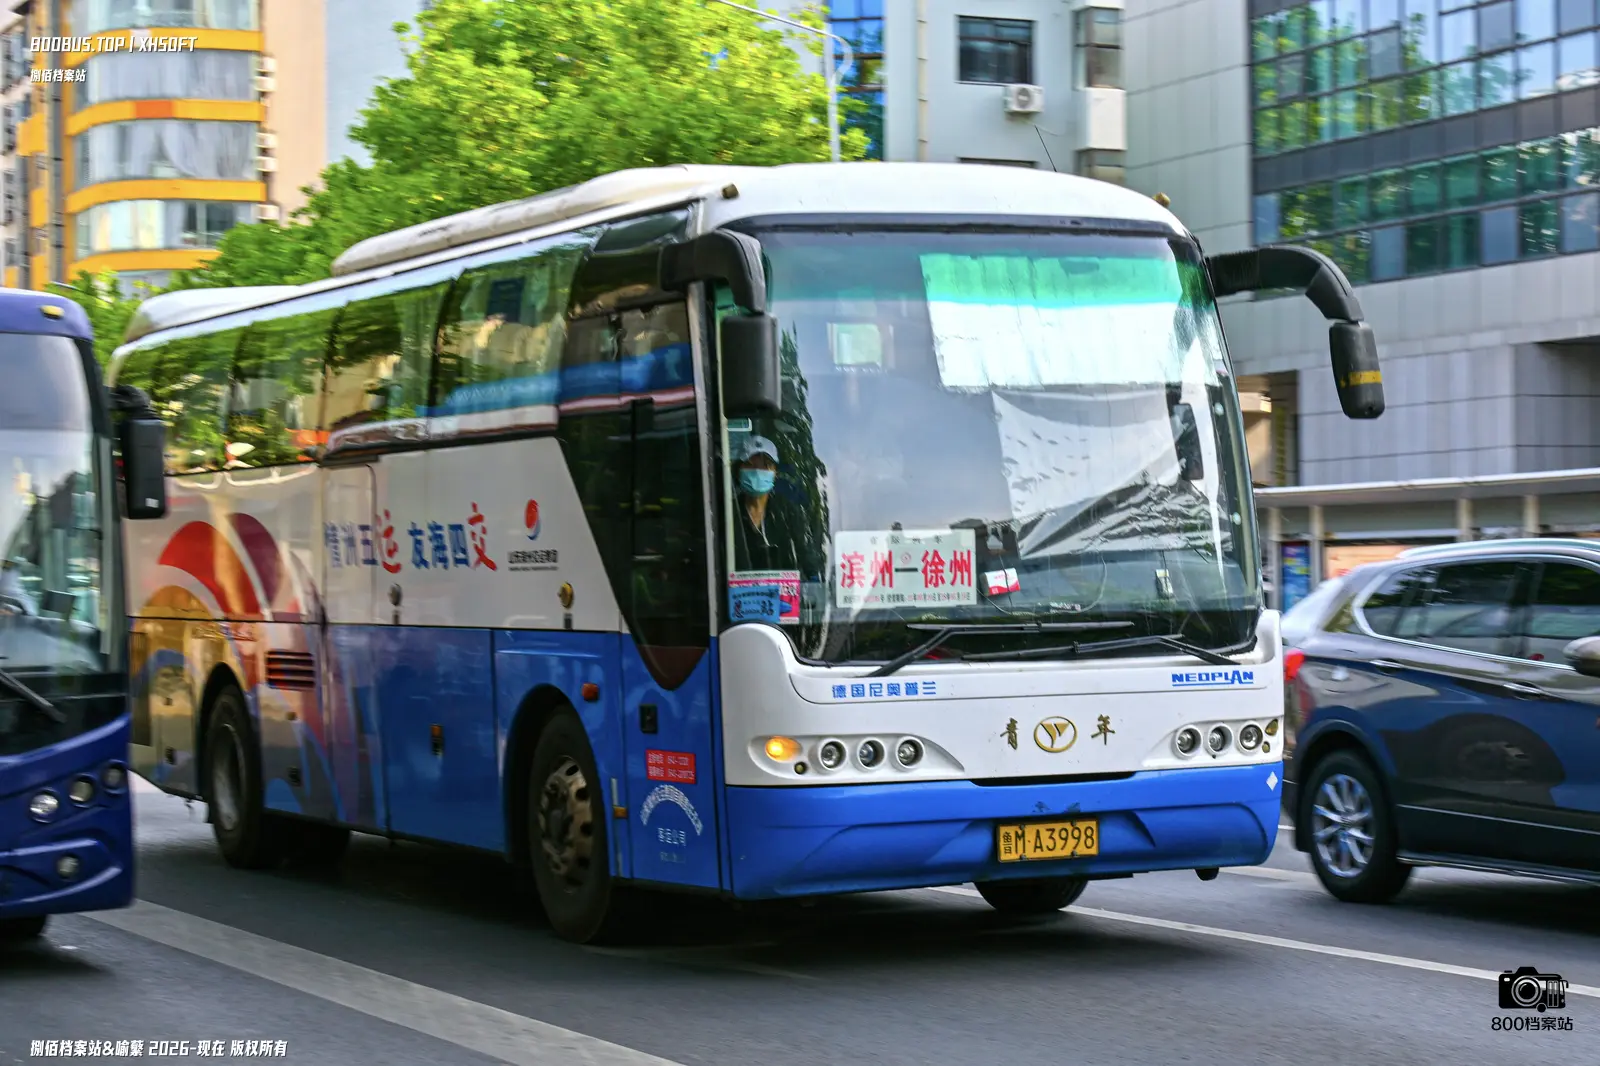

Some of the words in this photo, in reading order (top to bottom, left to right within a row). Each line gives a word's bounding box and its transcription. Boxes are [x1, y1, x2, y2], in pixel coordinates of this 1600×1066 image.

[1171, 669, 1255, 686] NEOPLAN
[831, 680, 937, 699] 德国尼奥普兰
